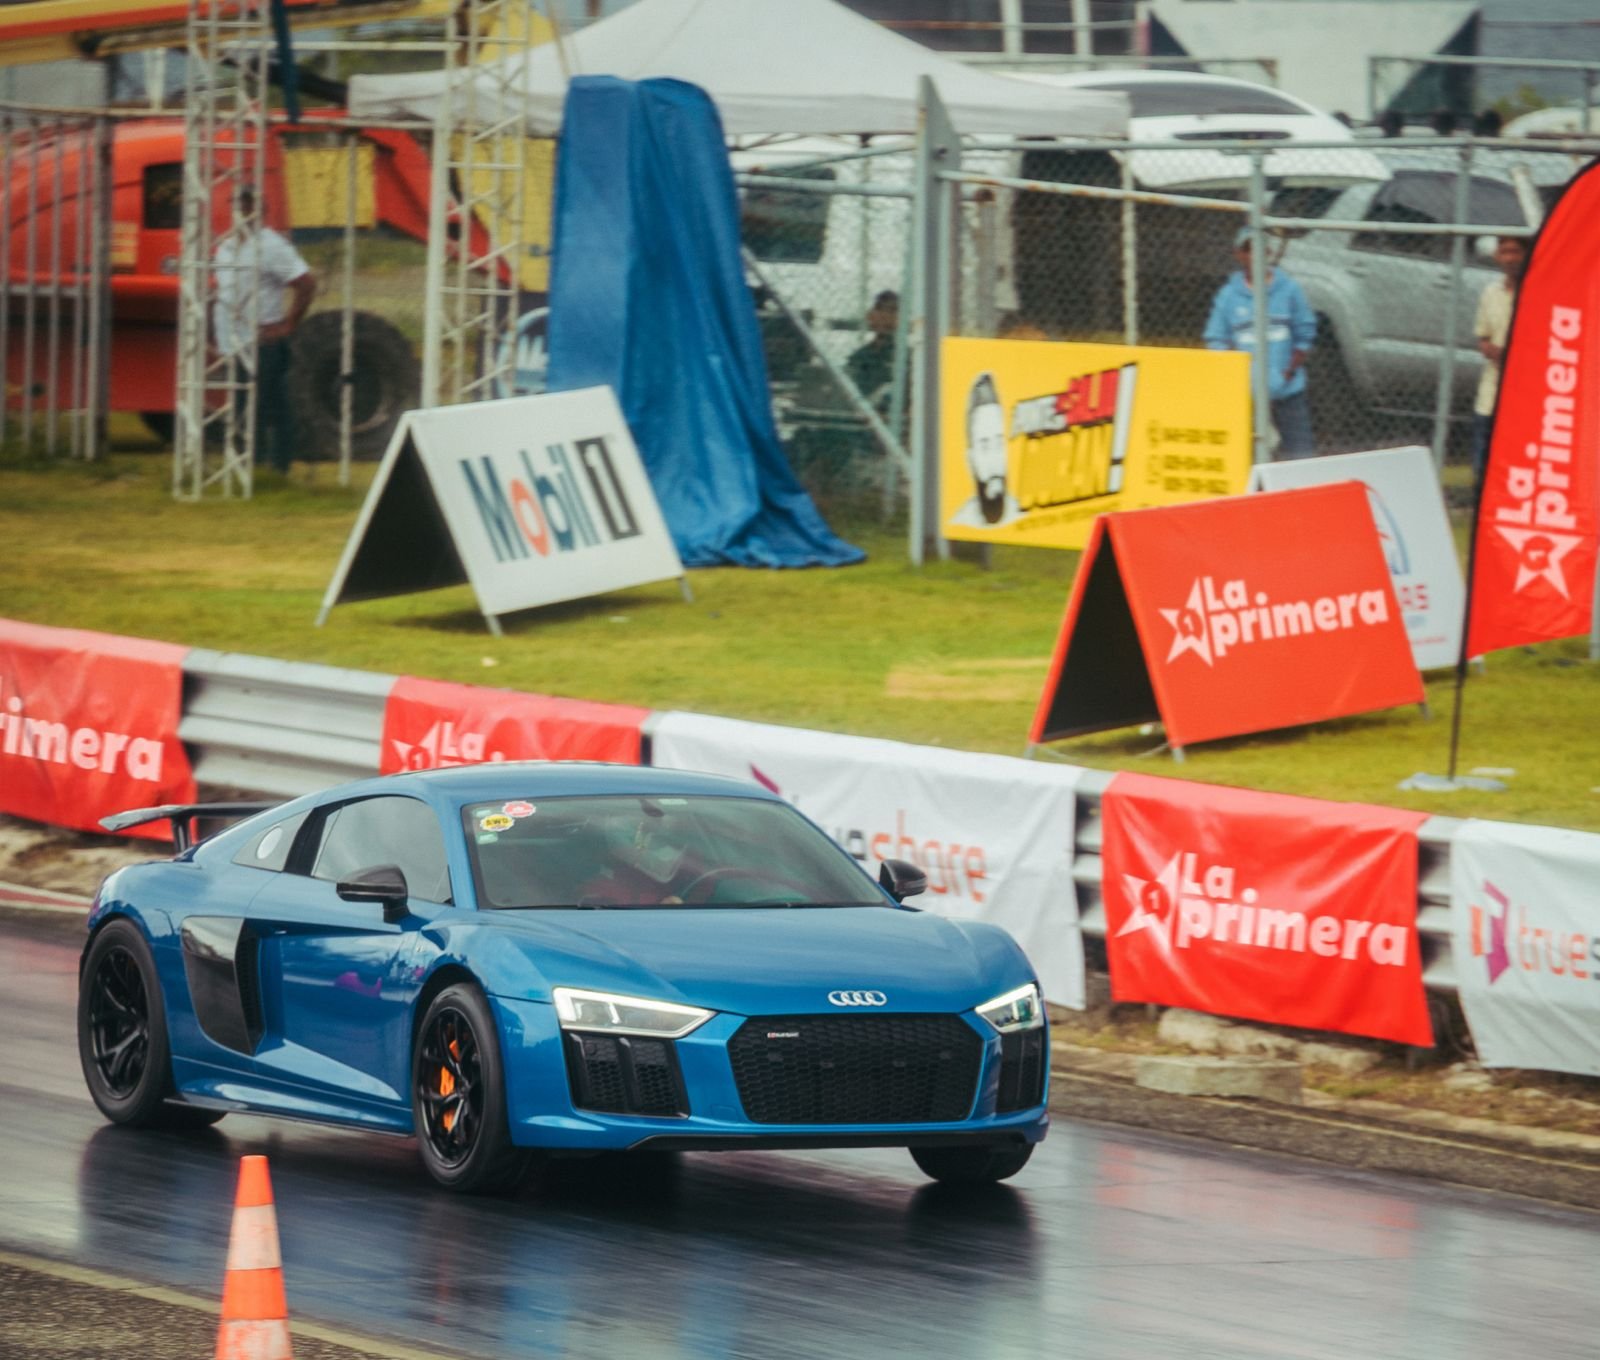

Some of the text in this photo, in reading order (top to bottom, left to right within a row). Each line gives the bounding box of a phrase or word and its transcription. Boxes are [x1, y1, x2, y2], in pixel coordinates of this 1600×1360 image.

[1525, 305, 1582, 530] primera
[459, 443, 602, 563] Mobil
[1495, 466, 1537, 524] La
[1203, 576, 1249, 613] La
[1210, 589, 1389, 657] primera
[0, 696, 165, 783] imera
[441, 721, 487, 760] La
[1183, 852, 1235, 899] La
[1176, 888, 1409, 967] primera
